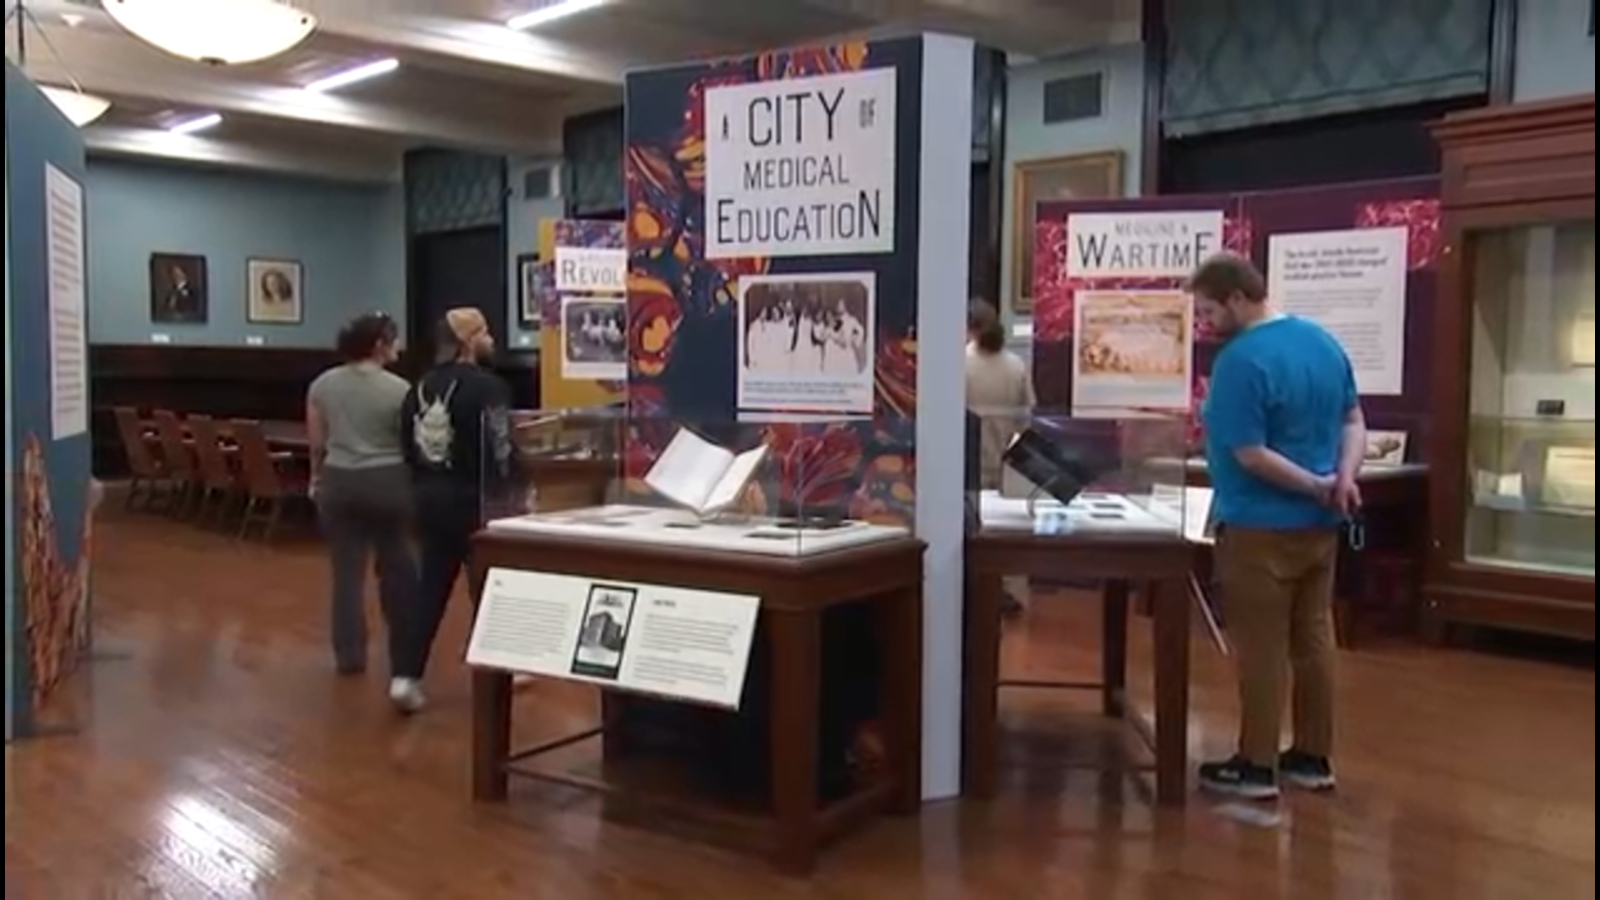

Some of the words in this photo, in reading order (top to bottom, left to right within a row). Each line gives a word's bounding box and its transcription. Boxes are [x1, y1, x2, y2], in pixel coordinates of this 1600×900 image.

[722, 114, 729, 140] A
[747, 87, 845, 147] CITY
[859, 98, 876, 128] OF
[743, 154, 850, 191] MEDICAL
[717, 189, 881, 244] EDUCATION
